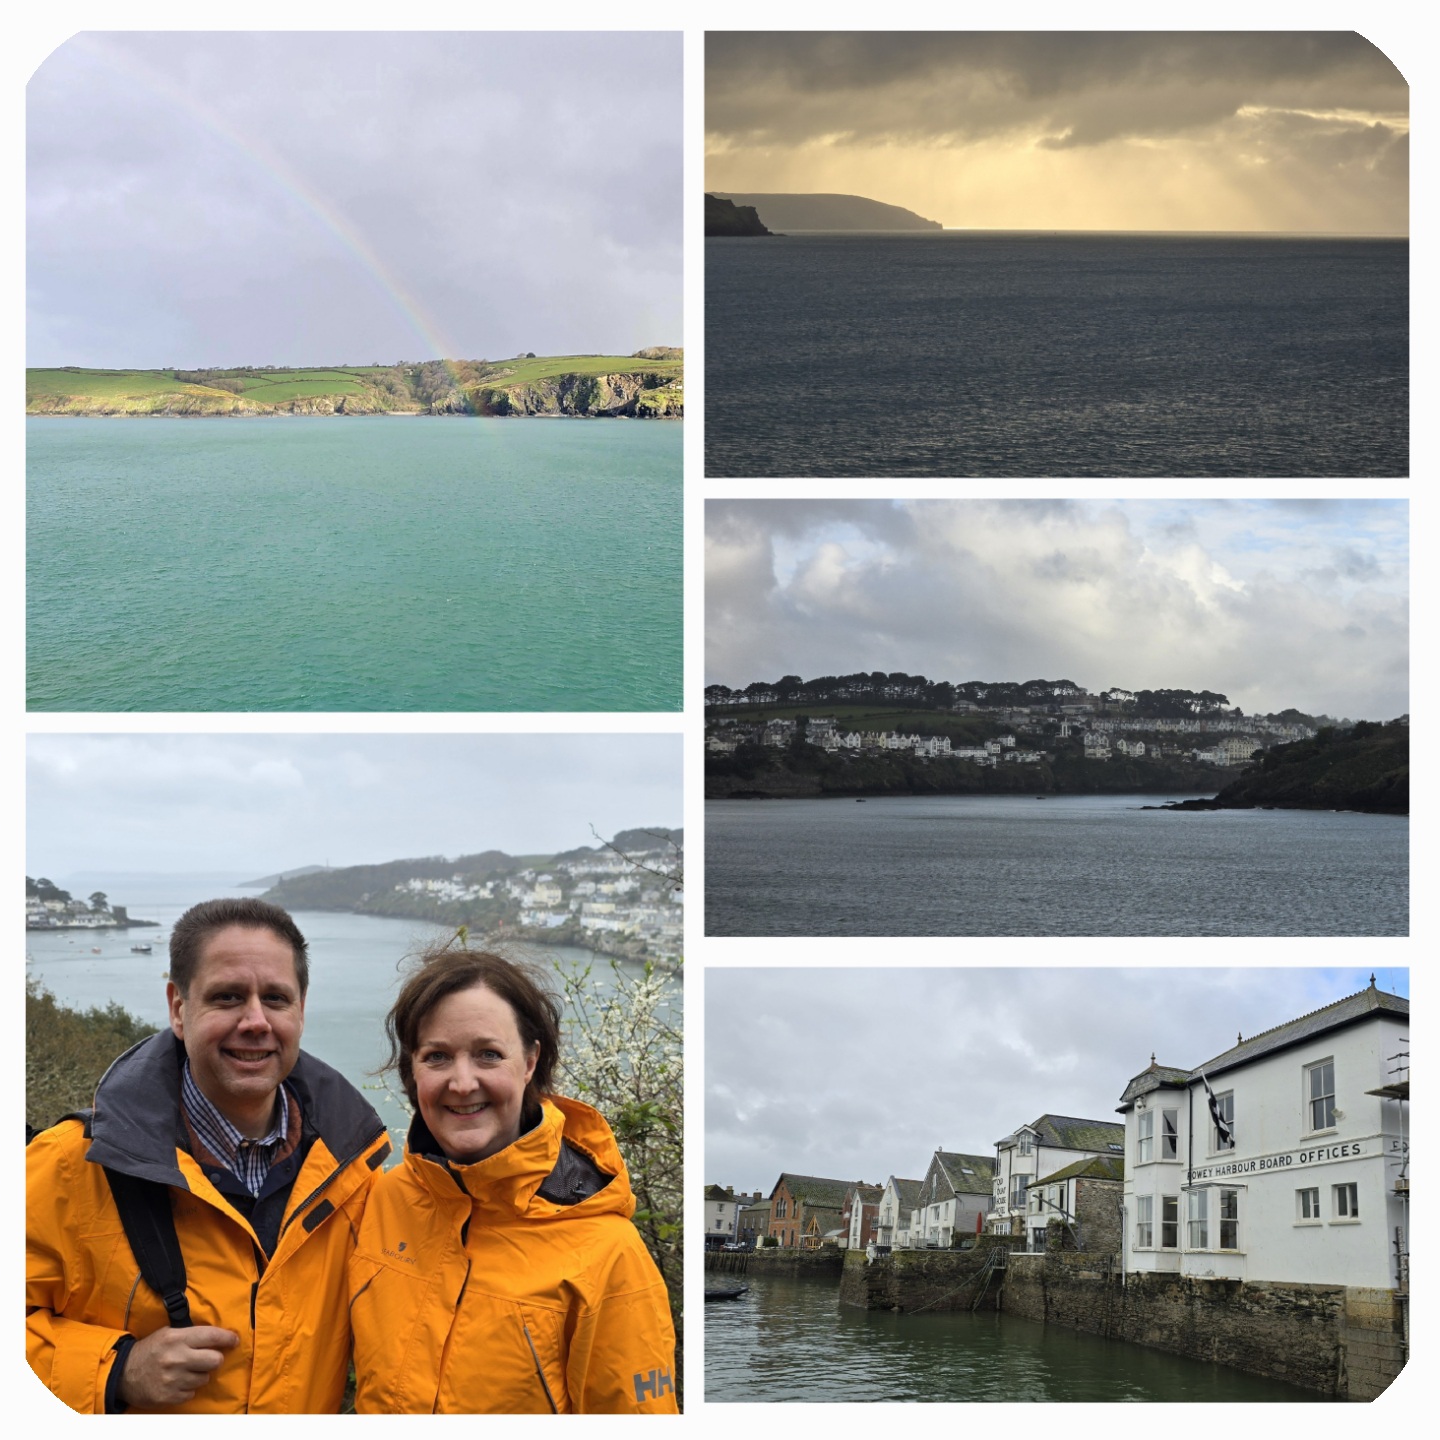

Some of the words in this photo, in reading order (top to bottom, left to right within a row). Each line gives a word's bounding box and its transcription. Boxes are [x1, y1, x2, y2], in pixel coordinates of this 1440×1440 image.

[1215, 1162, 1256, 1176] HARBOUR
[1259, 1156, 1293, 1170] BOARD
[1299, 1144, 1360, 1163] OFFICES
[633, 1365, 675, 1403] HH
